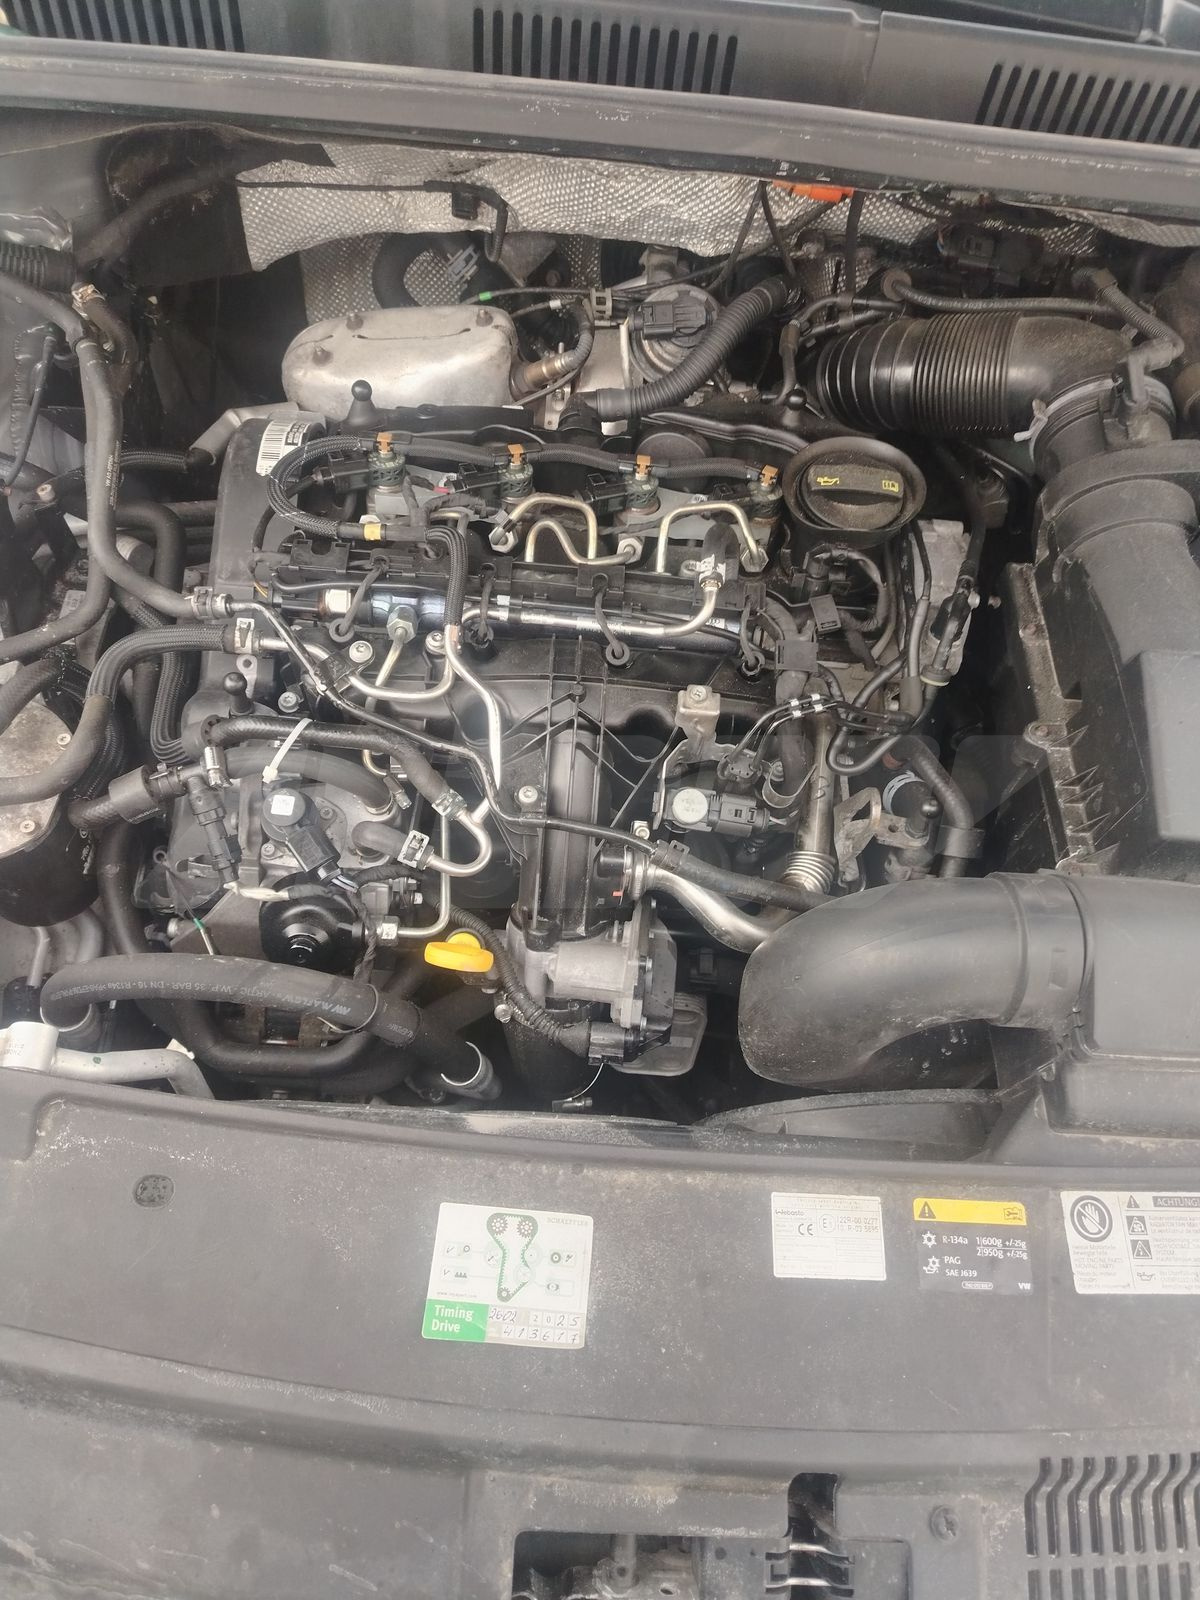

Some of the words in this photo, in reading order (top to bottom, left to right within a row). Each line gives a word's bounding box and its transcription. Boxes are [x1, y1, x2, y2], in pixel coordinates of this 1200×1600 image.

[150, 981, 164, 989] DN
[171, 982, 192, 990] BAR
[942, 1235, 968, 1244] R-134a
[1005, 1239, 1026, 1249] +/-25g
[1006, 1250, 1028, 1260] +/-25g
[944, 1256, 961, 1264] PAG
[945, 1269, 959, 1277] SAE
[1018, 1282, 1031, 1290] VW
[435, 1305, 475, 1321] Timing
[431, 1319, 461, 1333] Drive
